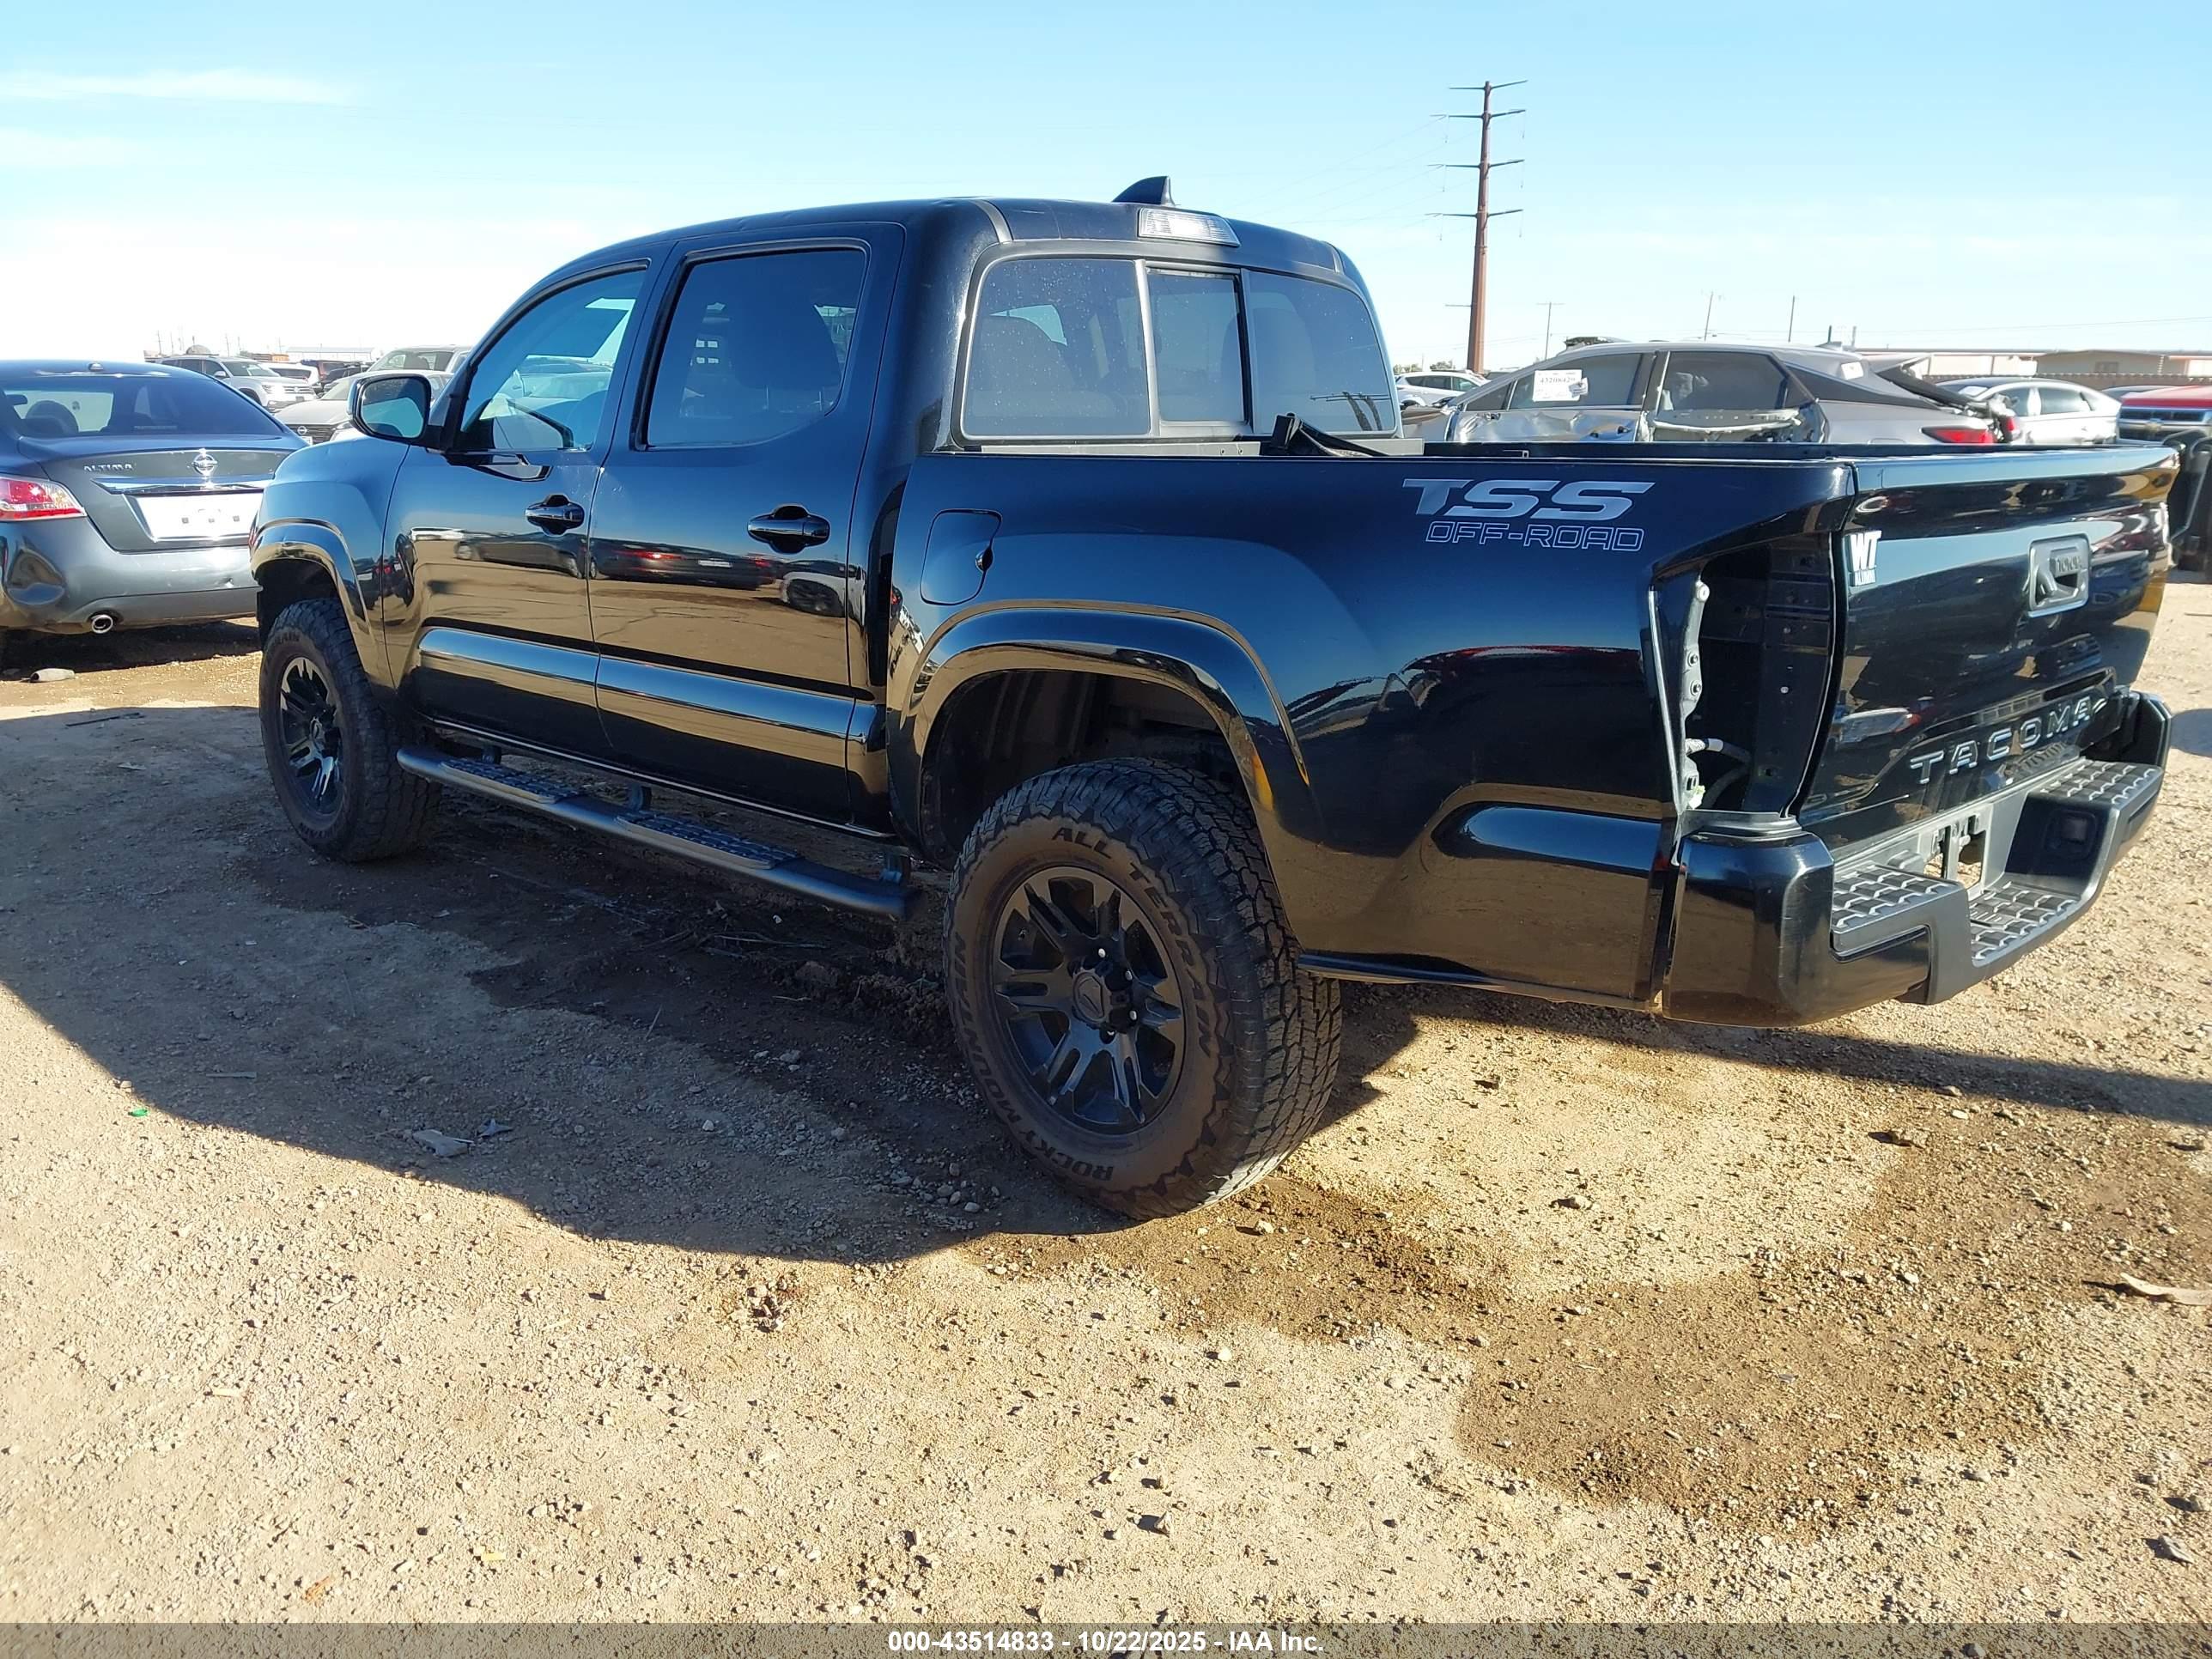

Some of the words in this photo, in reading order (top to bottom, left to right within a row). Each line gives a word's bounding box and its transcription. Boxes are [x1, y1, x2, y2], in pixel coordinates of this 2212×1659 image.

[82, 462, 135, 472] ALTIMA
[1402, 477, 1656, 521] TSS
[1425, 520, 1645, 552] OFF-ROAD
[1909, 696, 2094, 785] TACOMA
[1051, 826, 1113, 860] ALL
[1128, 861, 1212, 1059] TERRAIN
[953, 931, 1022, 1125] MOUNTAIN
[1018, 1128, 1115, 1182] ROCKY
